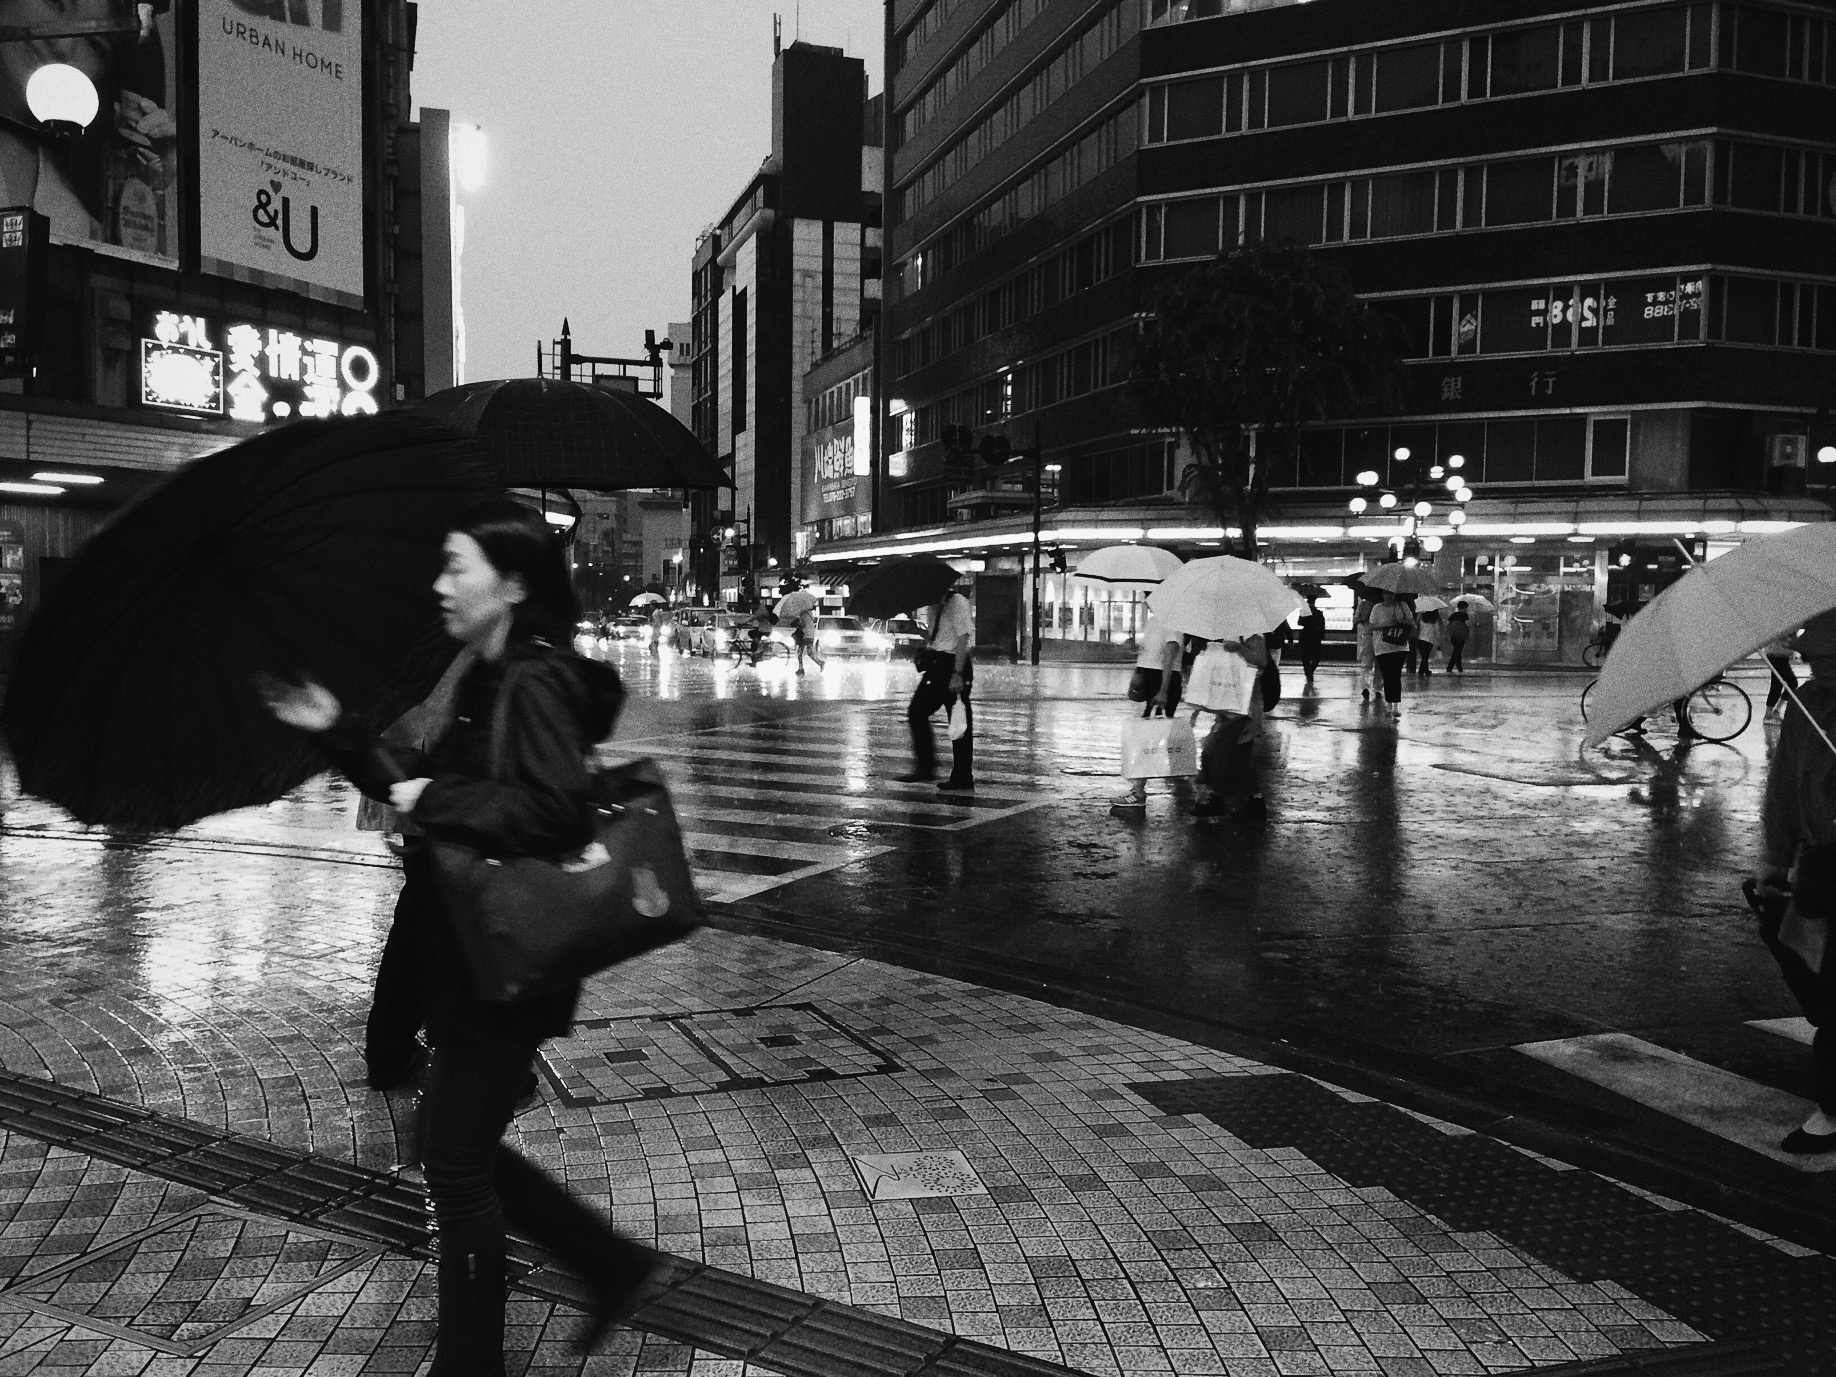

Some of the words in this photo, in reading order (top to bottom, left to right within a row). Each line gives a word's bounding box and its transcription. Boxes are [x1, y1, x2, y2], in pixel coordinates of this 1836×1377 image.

[222, 16, 285, 57] URBAN
[292, 46, 343, 81] HOME
[252, 188, 319, 261] &U
